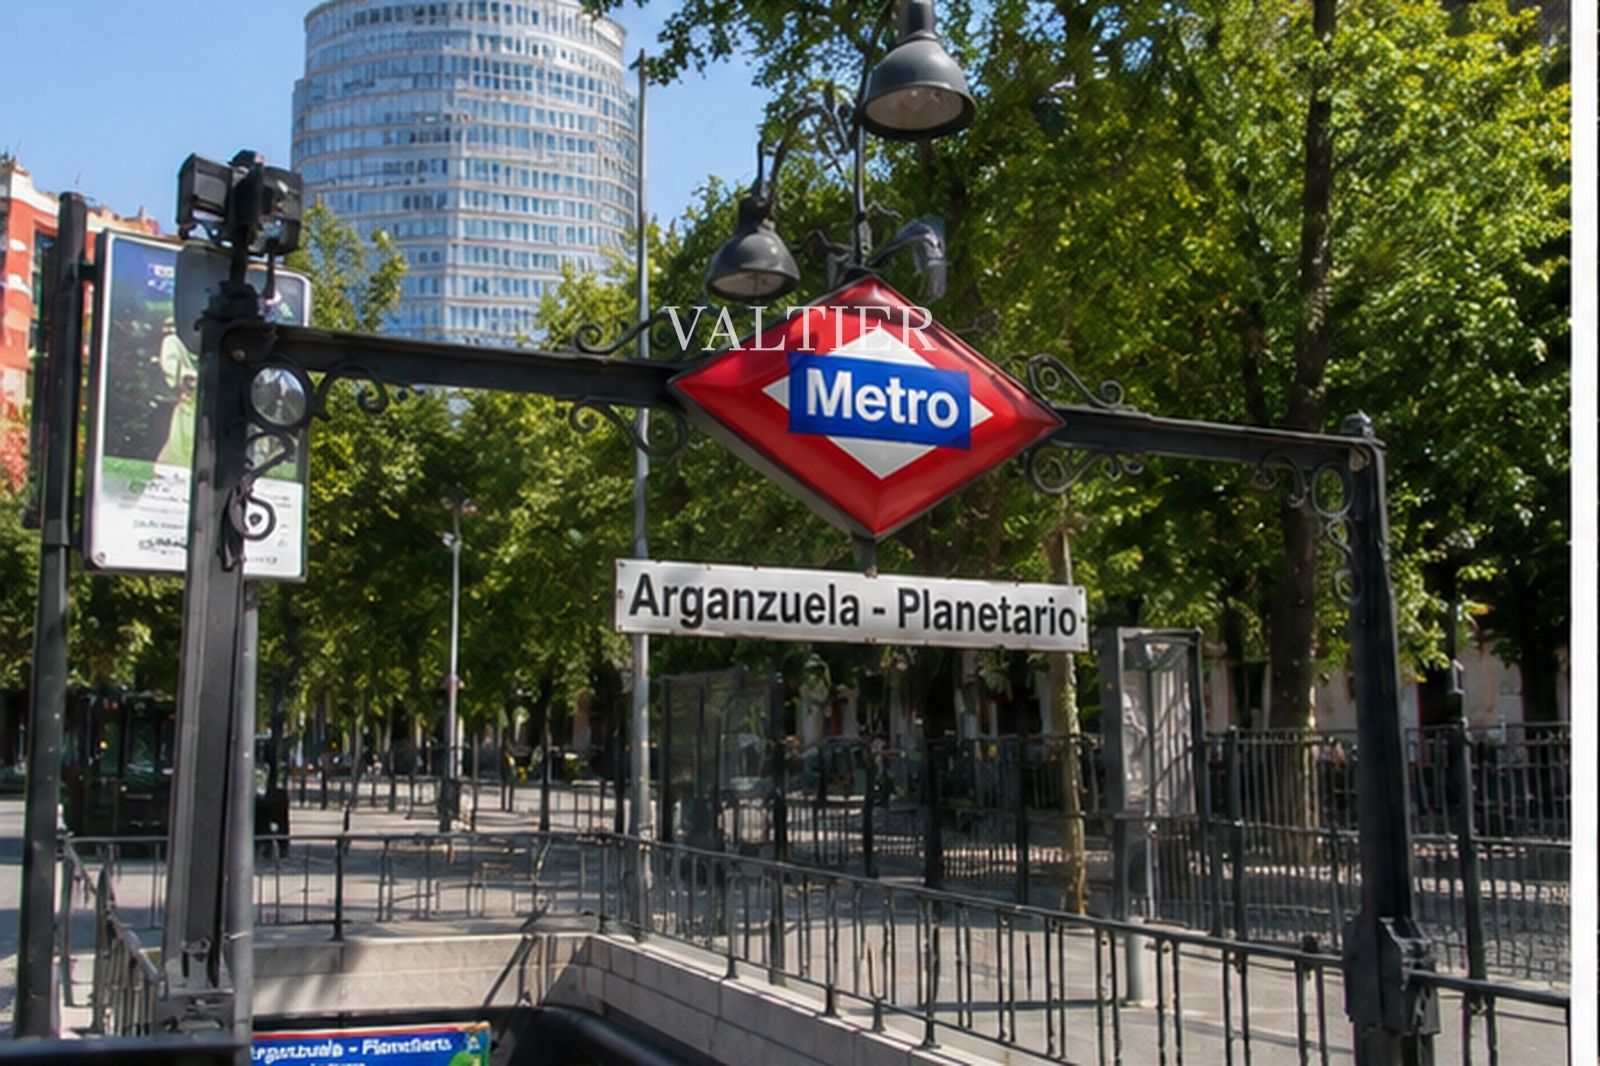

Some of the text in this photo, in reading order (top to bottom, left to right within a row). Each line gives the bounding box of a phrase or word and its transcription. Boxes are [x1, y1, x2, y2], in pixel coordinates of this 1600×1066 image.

[806, 367, 959, 429] Metro
[628, 572, 1077, 636] Arganzuela - Planetario
